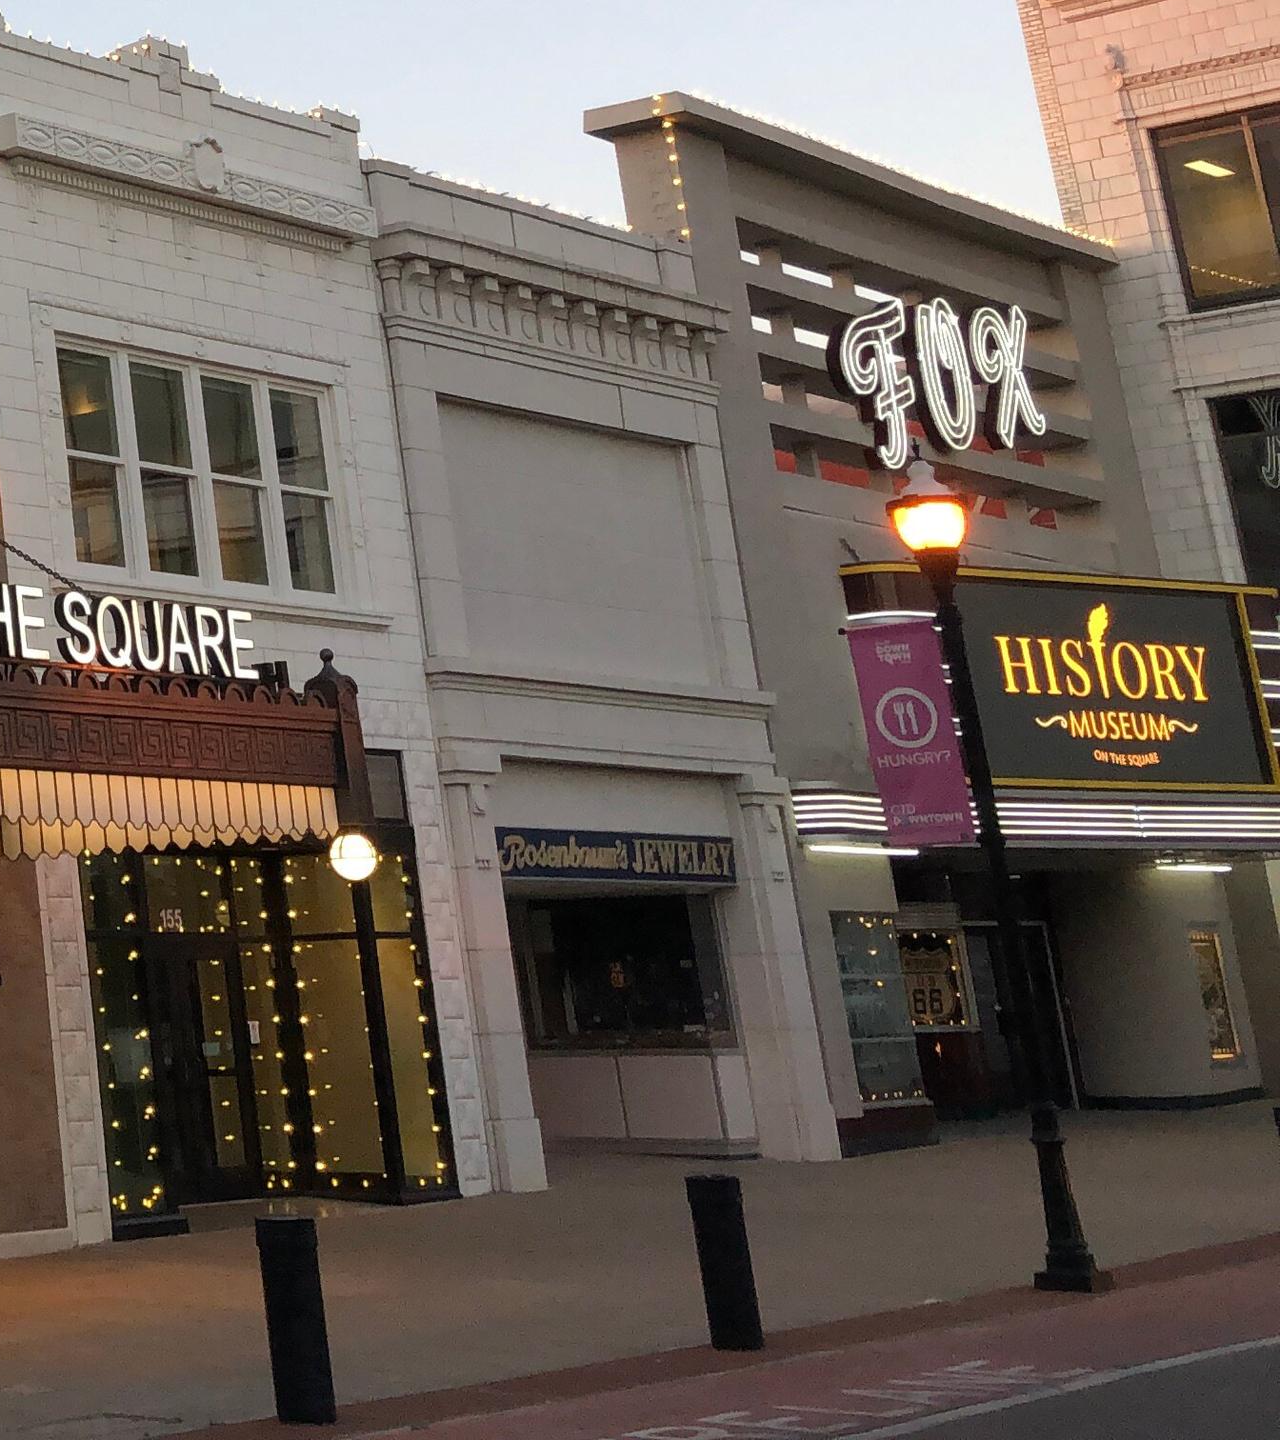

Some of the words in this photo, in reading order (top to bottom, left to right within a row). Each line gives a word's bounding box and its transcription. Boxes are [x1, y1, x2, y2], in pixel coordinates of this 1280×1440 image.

[841, 297, 1046, 470] FOX
[66, 592, 260, 680] SQUARE
[994, 602, 1209, 703] HISTORY
[1069, 710, 1171, 741] MUSEUM
[877, 749, 952, 768] HUNGRY?
[1093, 749, 1109, 763] ON
[1109, 752, 1127, 765] THE
[1127, 752, 1161, 768] SQUARE
[631, 838, 734, 876] JEWELRY
[159, 908, 184, 929] 155
